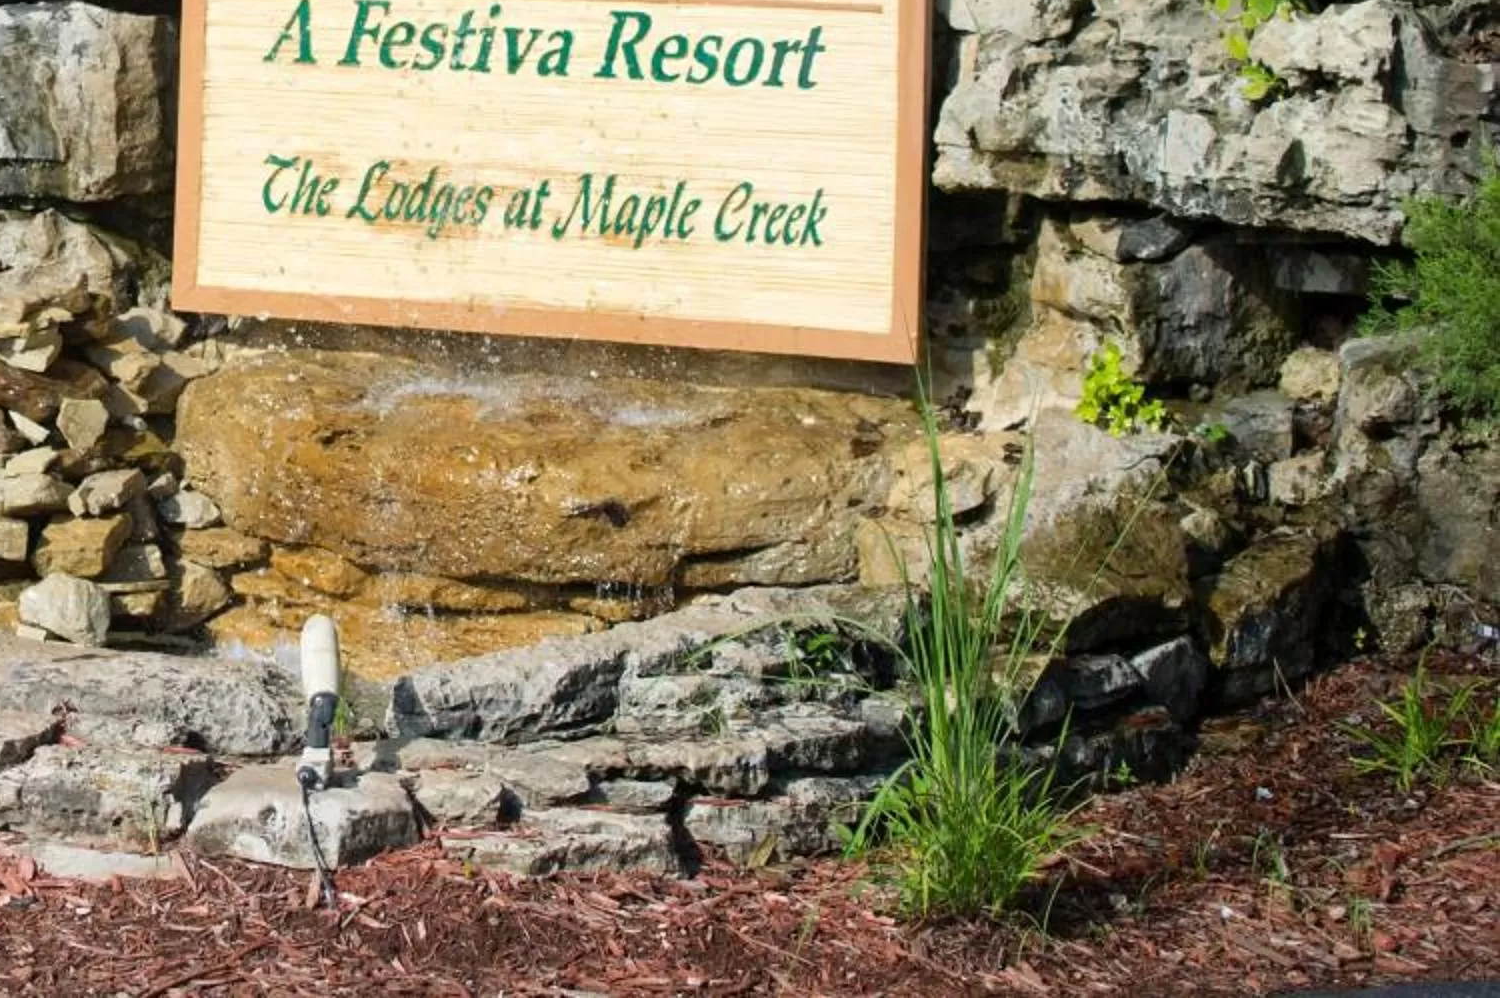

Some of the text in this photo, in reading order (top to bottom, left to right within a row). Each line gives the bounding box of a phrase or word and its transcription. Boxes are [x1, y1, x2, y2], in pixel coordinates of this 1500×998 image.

[336, 0, 573, 77] Festiva
[594, 10, 826, 88] Resort
[262, 155, 827, 248] The Lodges at Maple Creek
